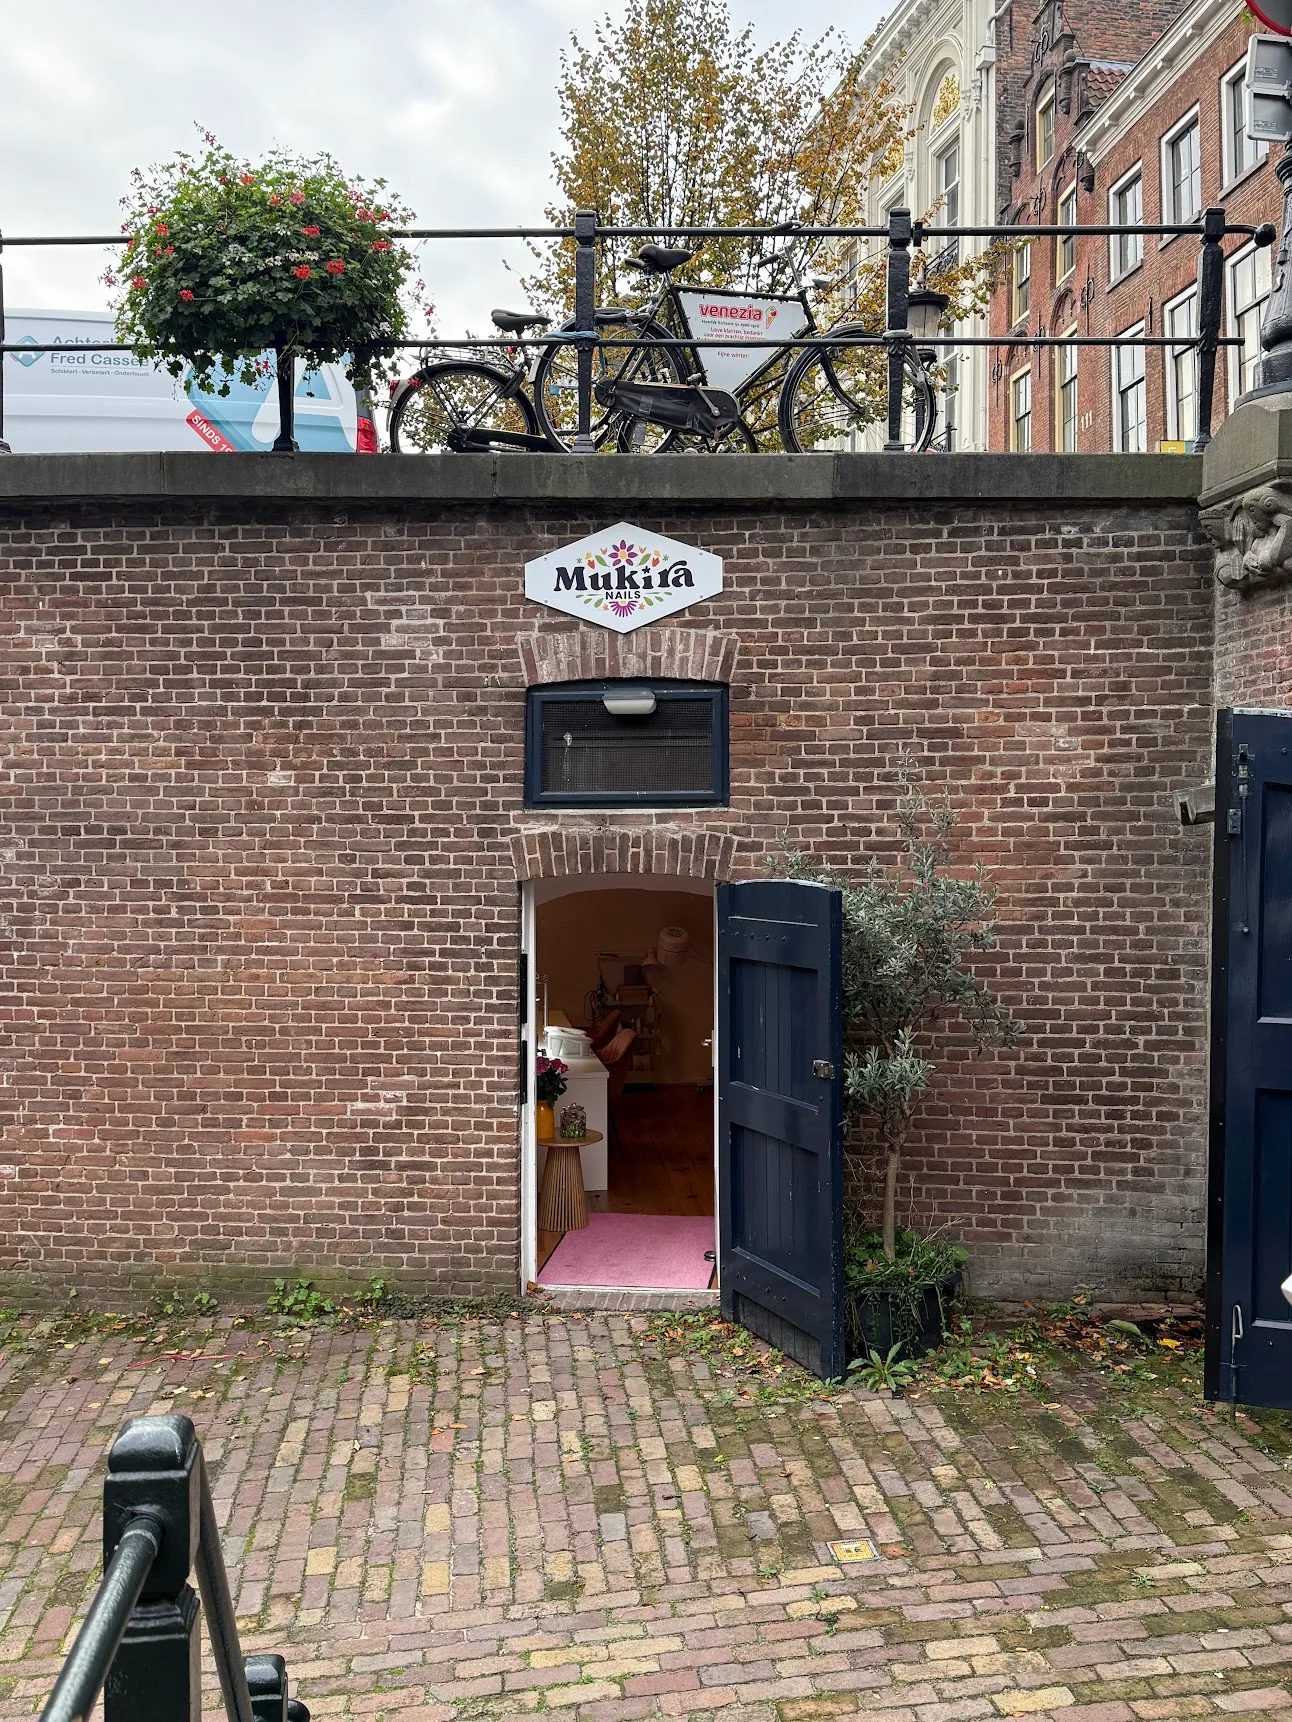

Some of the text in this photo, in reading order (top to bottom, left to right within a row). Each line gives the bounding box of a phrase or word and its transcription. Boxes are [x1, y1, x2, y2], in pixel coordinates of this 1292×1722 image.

[699, 303, 763, 322] venezia
[51, 352, 86, 364] Fred
[191, 415, 221, 445] SINDS
[1080, 410, 1093, 431] 111
[553, 560, 695, 592] Mukira
[605, 590, 641, 600] NAILS
